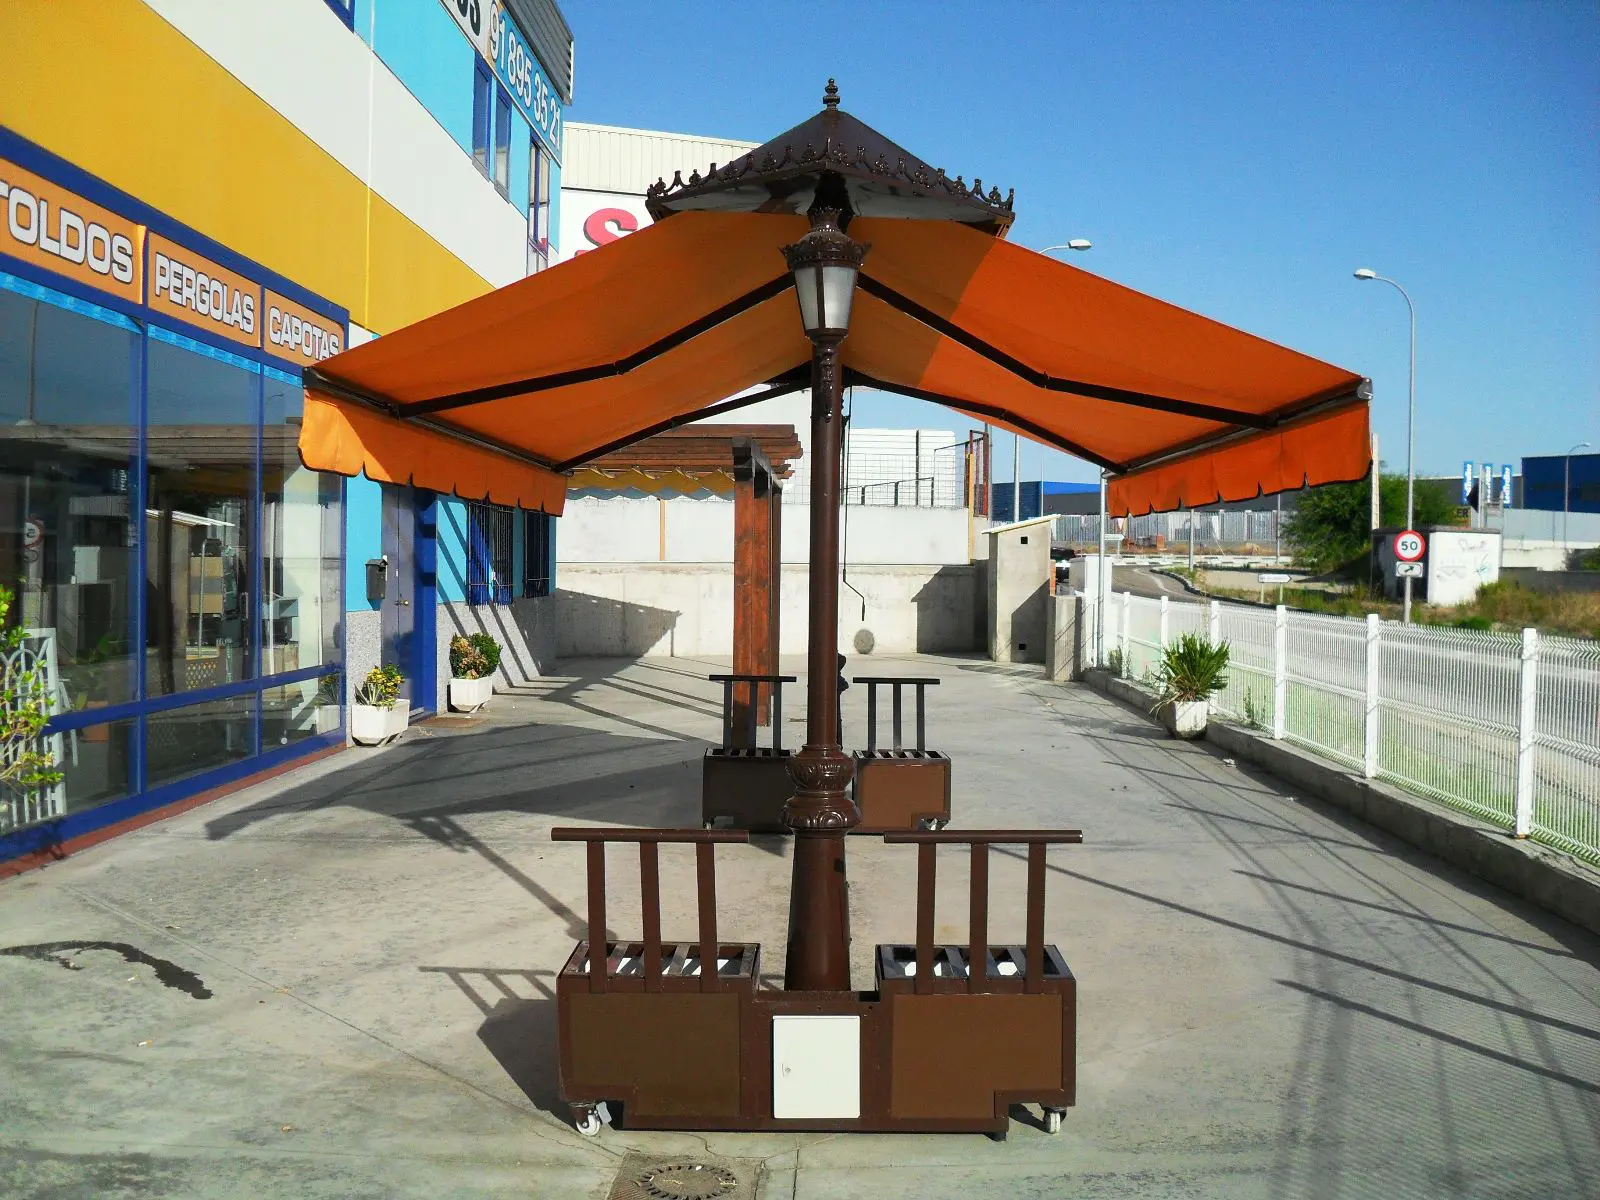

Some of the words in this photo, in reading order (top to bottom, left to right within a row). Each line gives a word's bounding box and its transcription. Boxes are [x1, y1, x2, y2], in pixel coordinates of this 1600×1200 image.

[490, 2, 506, 72] 91
[507, 31, 532, 108] 895
[533, 72, 548, 132] 35
[549, 96, 561, 149] 21
[155, 252, 255, 334] PERGOLAS
[268, 304, 341, 361] CAPOTAS
[1401, 540, 1418, 551] 50
